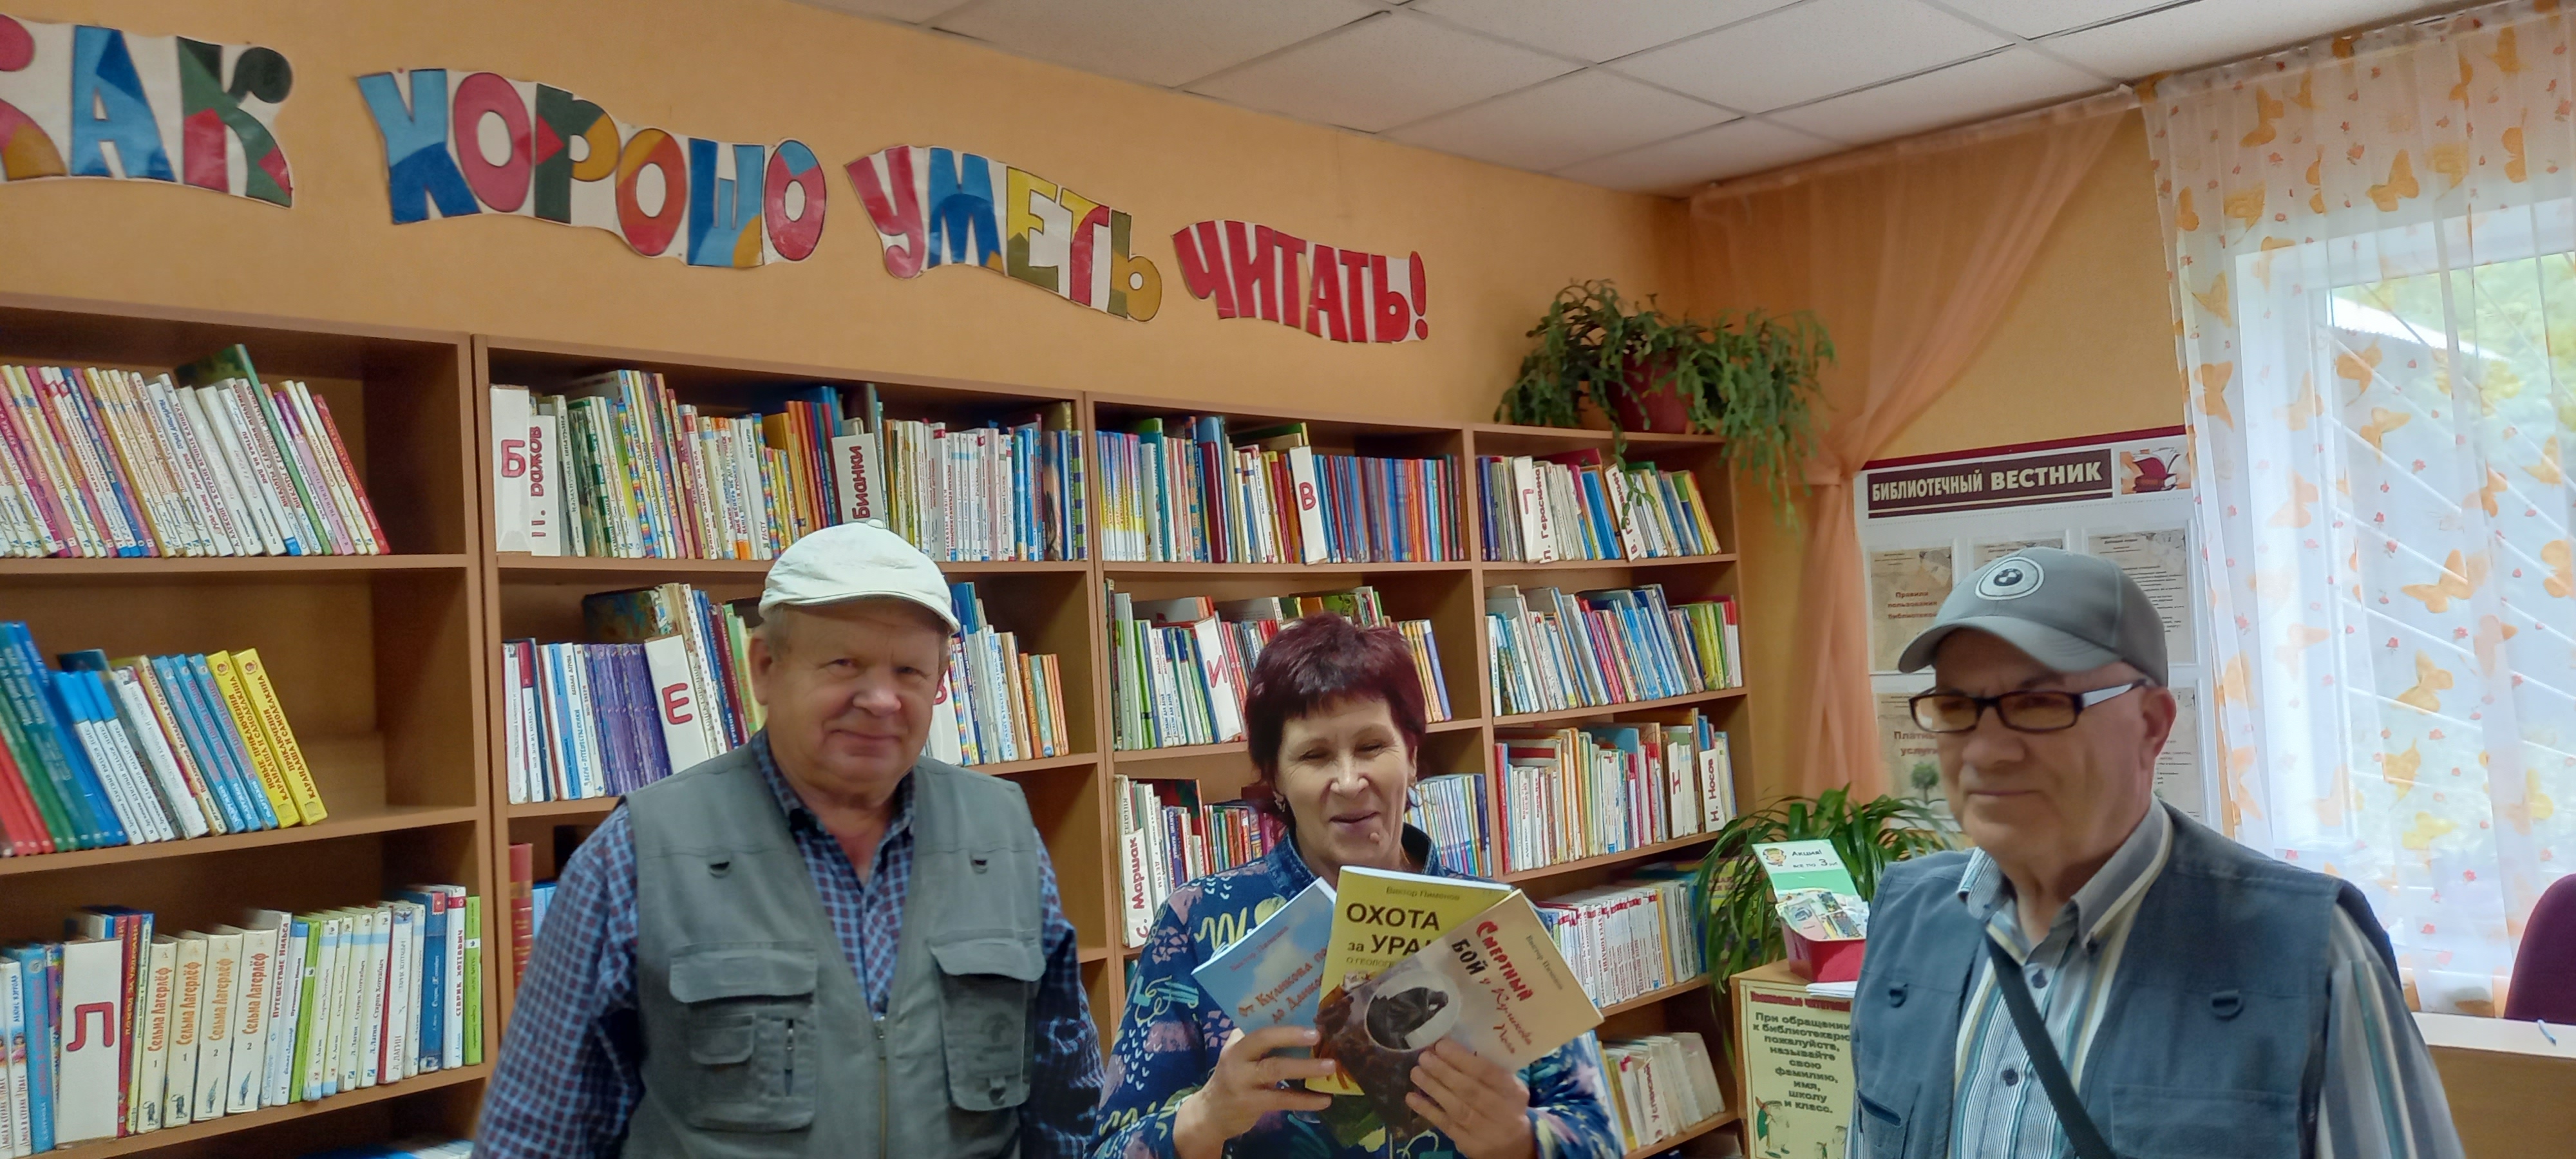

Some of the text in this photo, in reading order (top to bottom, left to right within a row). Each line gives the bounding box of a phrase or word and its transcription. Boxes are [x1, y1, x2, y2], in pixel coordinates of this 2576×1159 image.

[357, 68, 826, 268] ХОРОШО
[844, 146, 1162, 322] УМЕТЬ
[1171, 220, 1428, 344] ЧИТАТЬ!
[187, 437, 204, 467] ВЕЧНЫХ
[500, 439, 526, 478] Б
[200, 467, 216, 494] СТРАНЕ
[851, 445, 871, 520] Бианки
[1300, 482, 1316, 511] В
[1872, 461, 2103, 502] БИБЛИОТЕЧНЫЙ ВЕСТНИК
[1522, 489, 1534, 514] Г
[1535, 469, 1549, 540] Гераскина
[1613, 472, 1632, 534] Говкин
[218, 507, 236, 540] АЛЕКСИН
[1207, 654, 1227, 688] И
[228, 675, 261, 739] САМОДЕЛКИНА
[256, 675, 289, 737] САМОДЕЛКИНА
[661, 683, 693, 725] Е
[227, 693, 275, 789] НОВЫЕ ПРИКЛЮЧЕНИЯ
[262, 708, 296, 771] ПРИКЛЮЧЕНИЯ
[260, 747, 289, 800] КАРАНДАША
[287, 745, 316, 799] КАРАНДАША
[1708, 759, 1717, 800] Носов
[1131, 837, 1144, 910] Маршак
[1386, 886, 1460, 901] Виктор Пименов
[1347, 903, 1440, 931] ОХОТА
[1347, 934, 1431, 956] за УРА
[1452, 938, 1488, 975] БОЙ
[272, 922, 289, 1018] ПУТЕШЕСТВИЕ НИЛЬСА
[375, 958, 384, 992] Хоттабыч
[147, 966, 172, 1051] Сельма Лагерлёф
[176, 961, 201, 1045] Сельма Лагерлёф
[207, 957, 233, 1041] Сельма Лагерлёф
[242, 952, 267, 1035] Сельма Лагерлёф
[372, 993, 381, 1018] Старик
[66, 1002, 114, 1051] Л
[369, 1024, 377, 1046] Лагин
[1756, 1012, 1778, 1022] При
[1764, 1035, 1840, 1052] пожалуйста,
[1770, 1047, 1835, 1061] называйте
[1775, 1067, 1839, 1084] фамилию,
[1789, 1060, 1821, 1069] свою
[1788, 1090, 1827, 1103] школу
[1794, 1081, 1821, 1092] имя,
[1795, 1102, 1833, 1113] класс.
